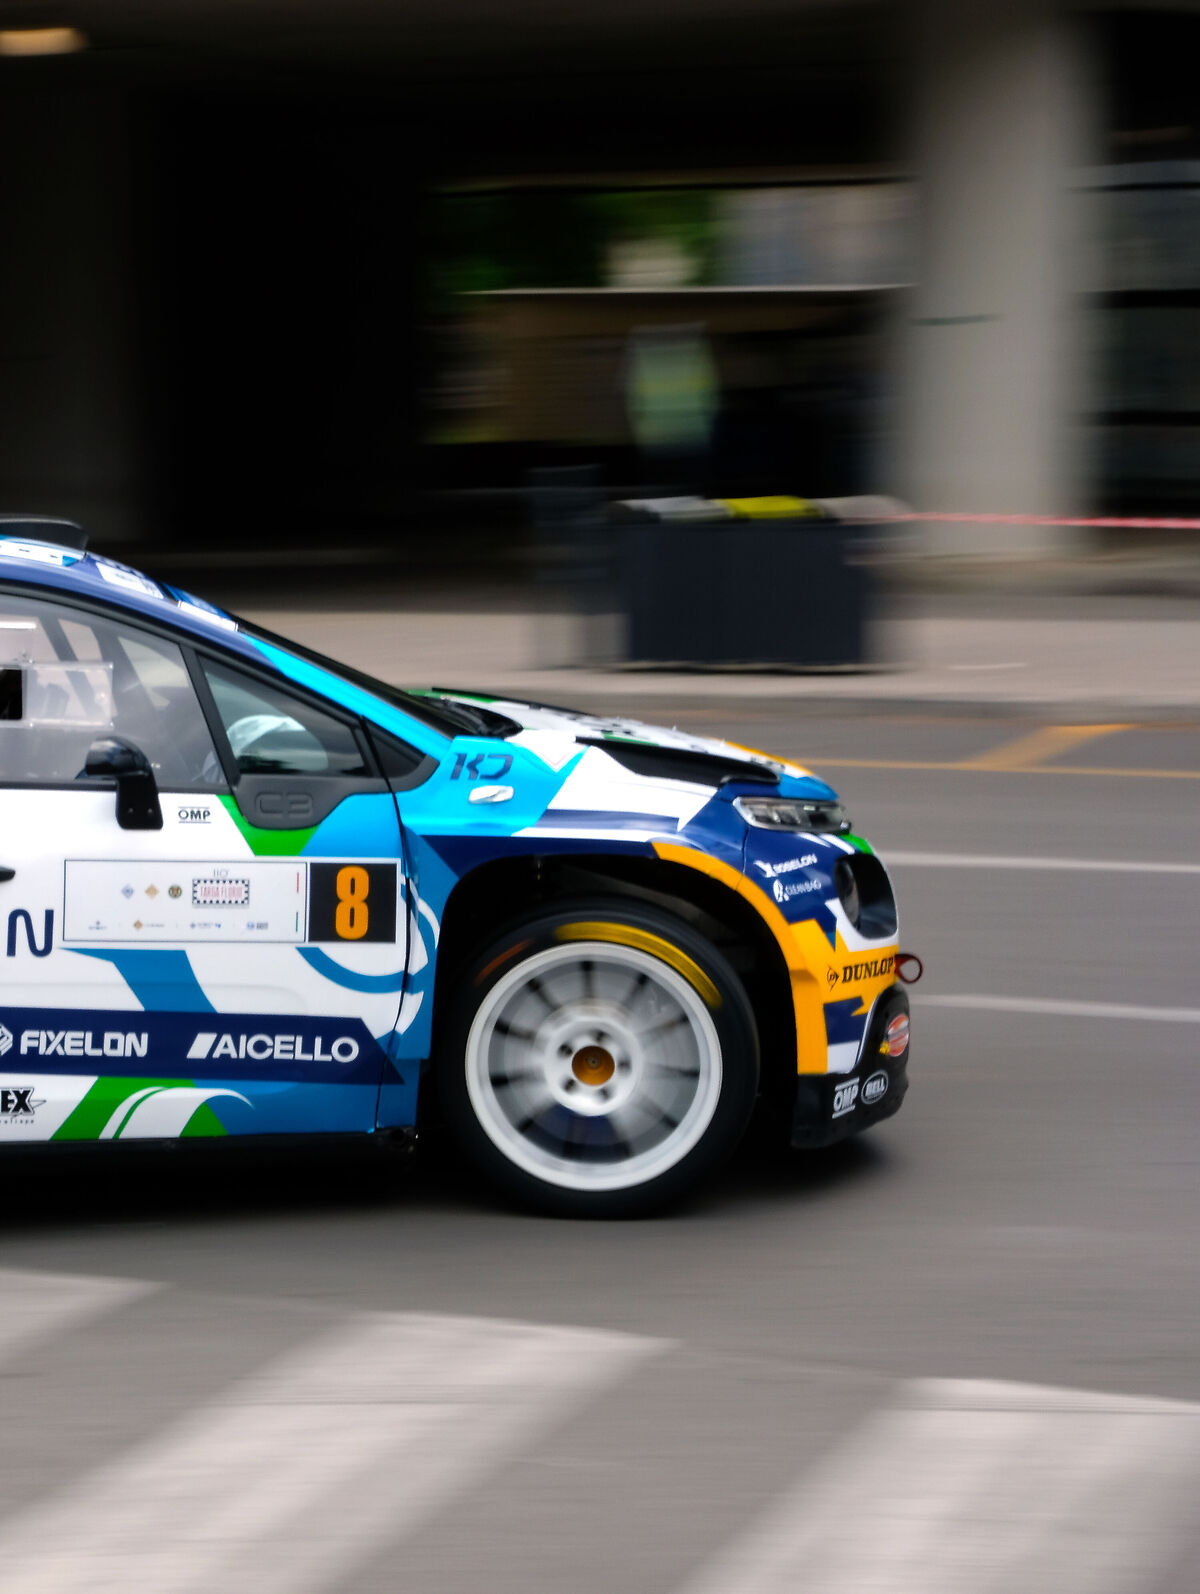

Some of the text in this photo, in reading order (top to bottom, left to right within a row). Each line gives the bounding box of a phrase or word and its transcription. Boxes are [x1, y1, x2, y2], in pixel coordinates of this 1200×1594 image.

[178, 808, 211, 821] OMP
[335, 865, 370, 941] 8
[842, 956, 894, 984] DUNLOP
[19, 1030, 149, 1058] FIXELON
[211, 1034, 360, 1064] AICELLO
[833, 1084, 859, 1112] OMP
[864, 1078, 887, 1097] BELL
